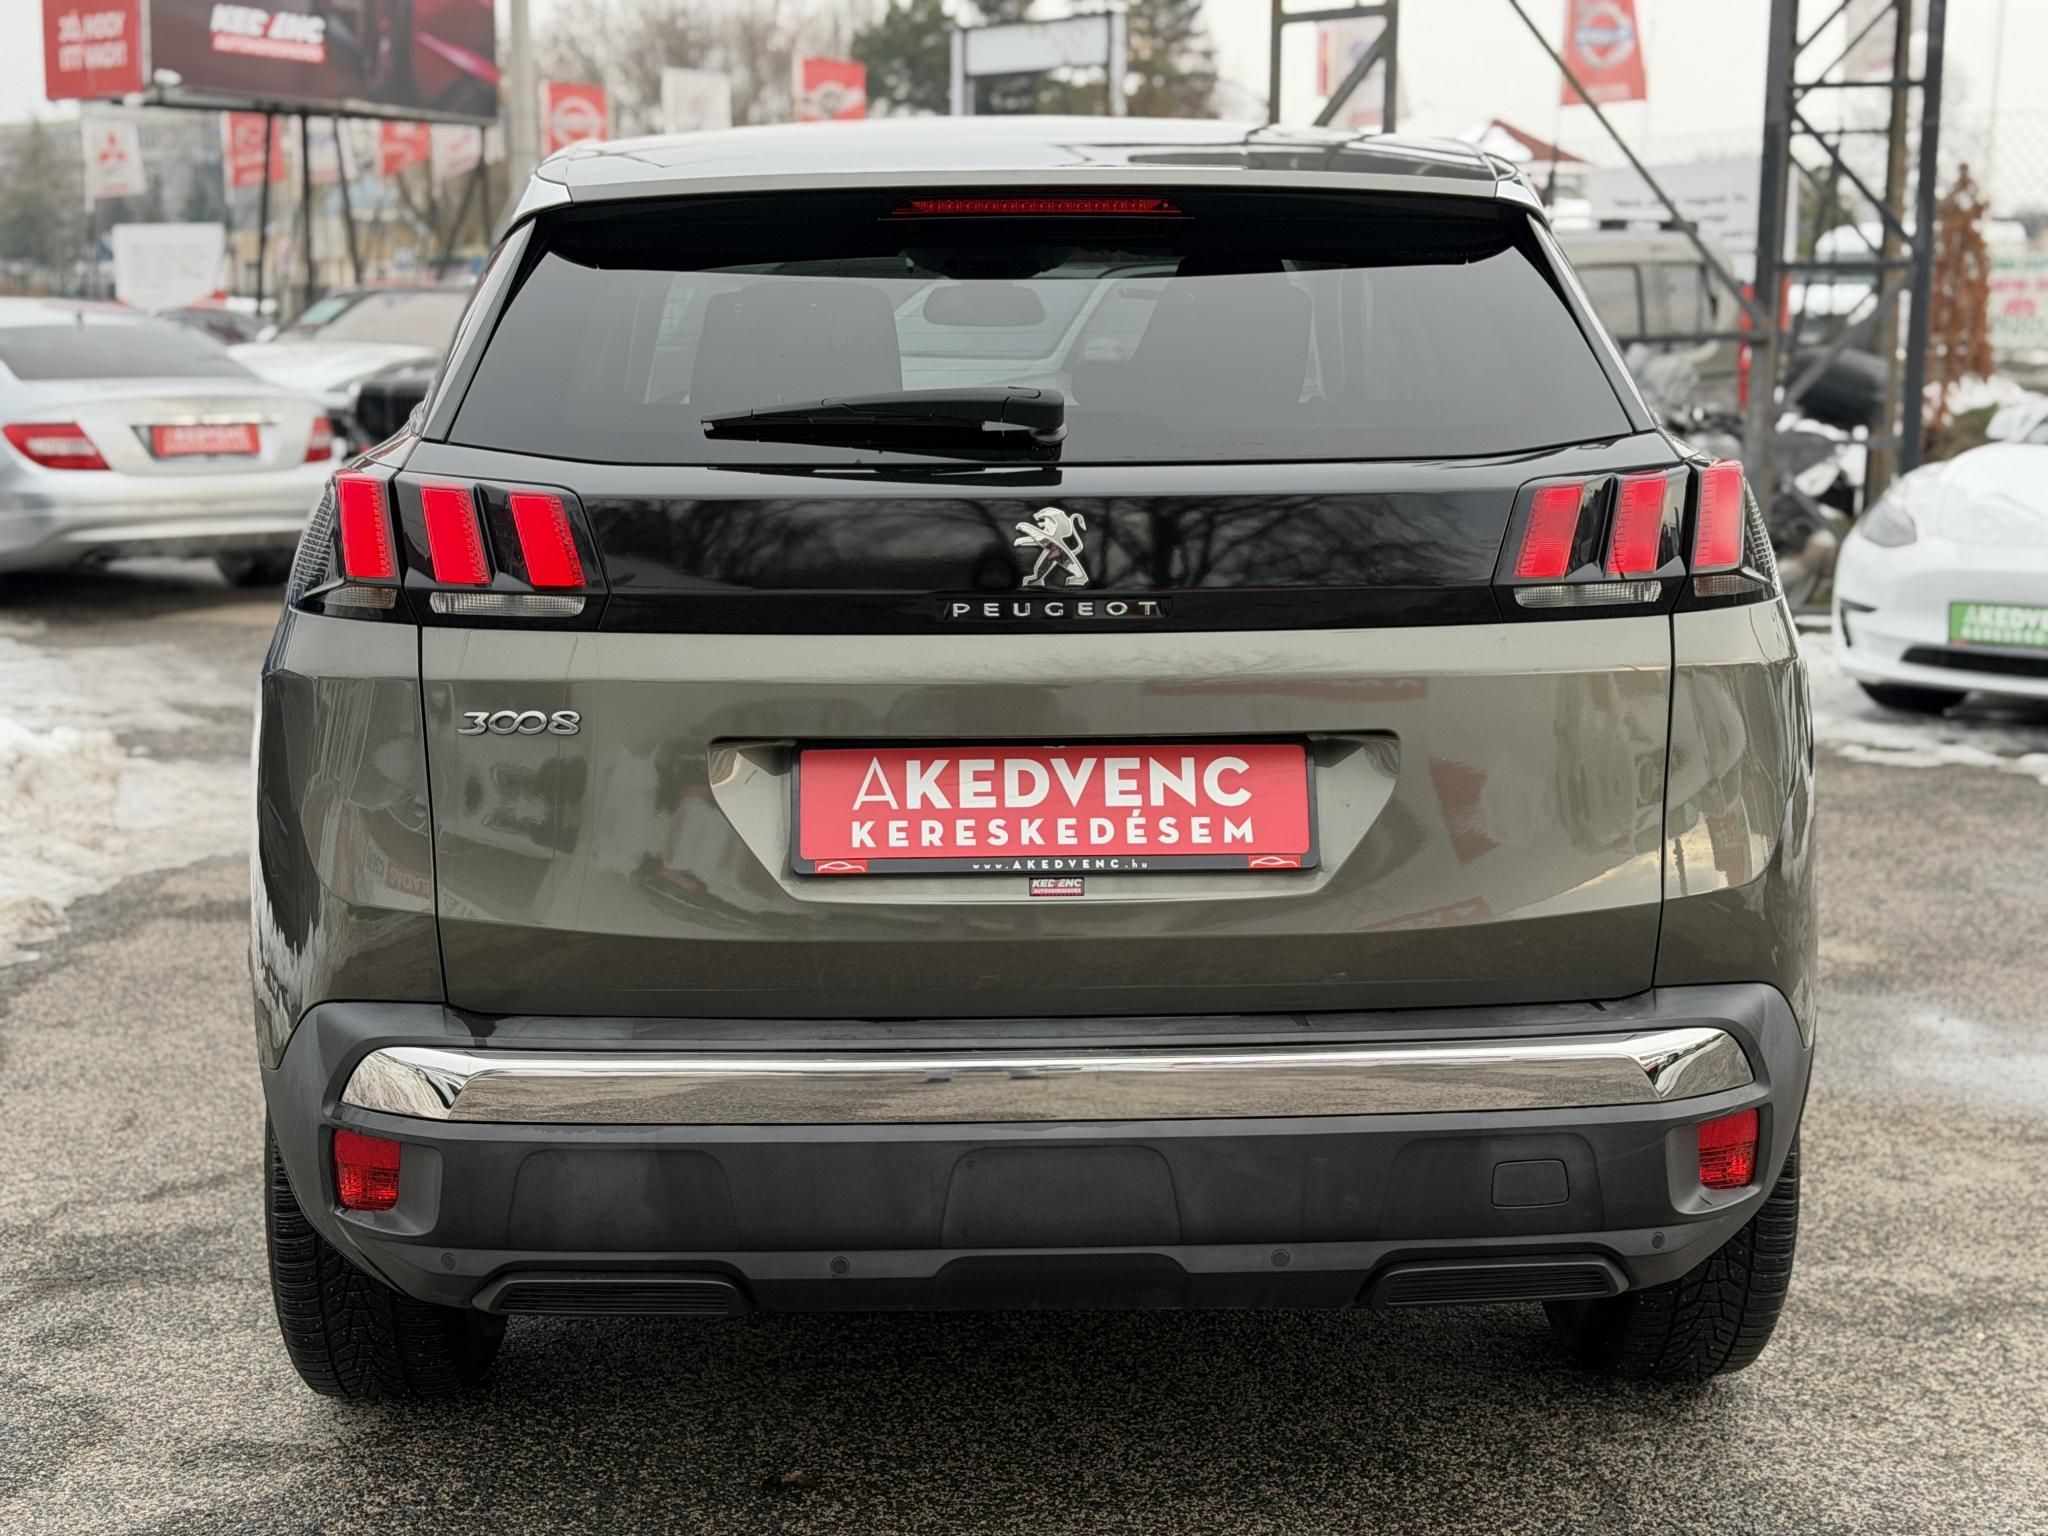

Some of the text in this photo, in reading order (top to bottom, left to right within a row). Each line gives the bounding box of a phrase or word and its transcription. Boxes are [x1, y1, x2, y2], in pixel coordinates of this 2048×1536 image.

[952, 601, 1157, 617] PEUGEOT
[457, 710, 580, 735] 3008
[852, 809, 1253, 848] KERESKEDÉSEM
[972, 859, 1148, 870] www.AKEDVENC.hu
